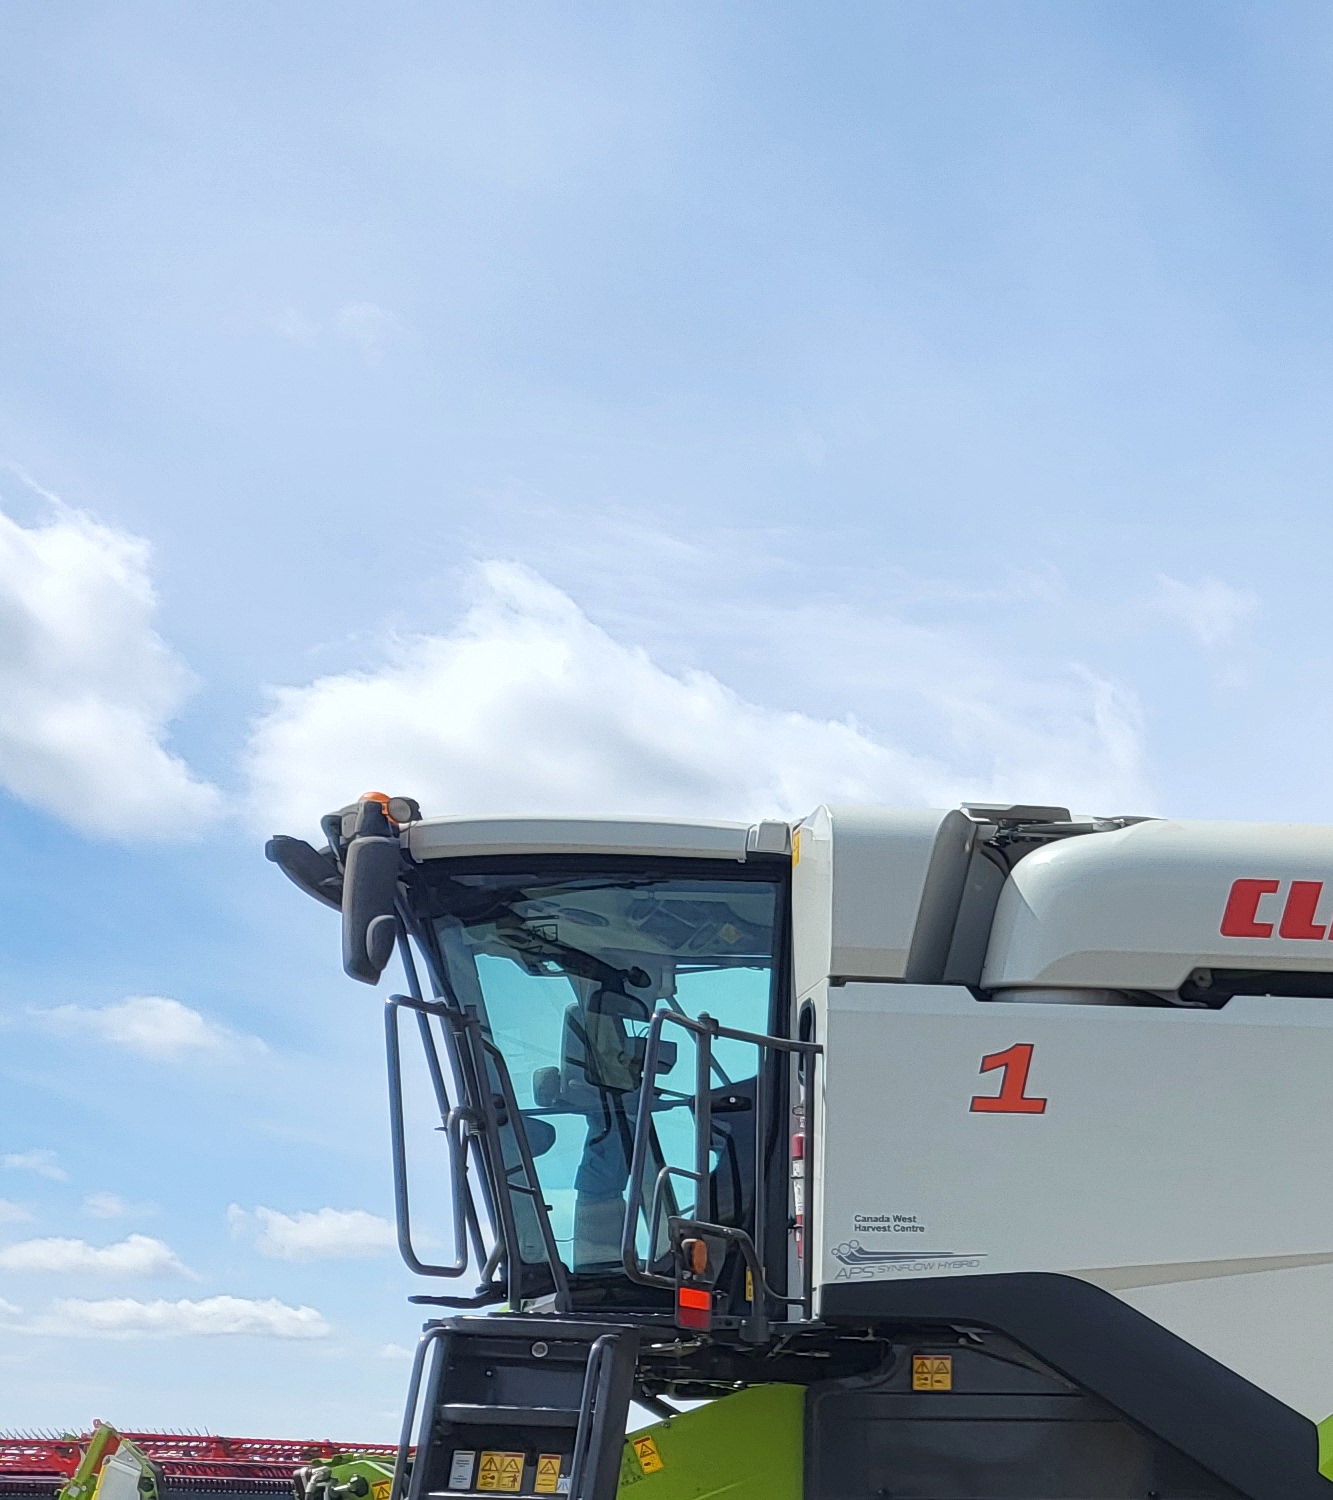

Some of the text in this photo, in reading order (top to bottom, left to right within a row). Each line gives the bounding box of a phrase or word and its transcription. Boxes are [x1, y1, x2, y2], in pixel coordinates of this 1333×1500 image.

[969, 1043, 1047, 1114] 1
[854, 1214, 917, 1223] Canada West
[854, 1224, 925, 1233] Harvest Centre
[834, 1260, 980, 1280] APS SYNFLOW HYBRID
